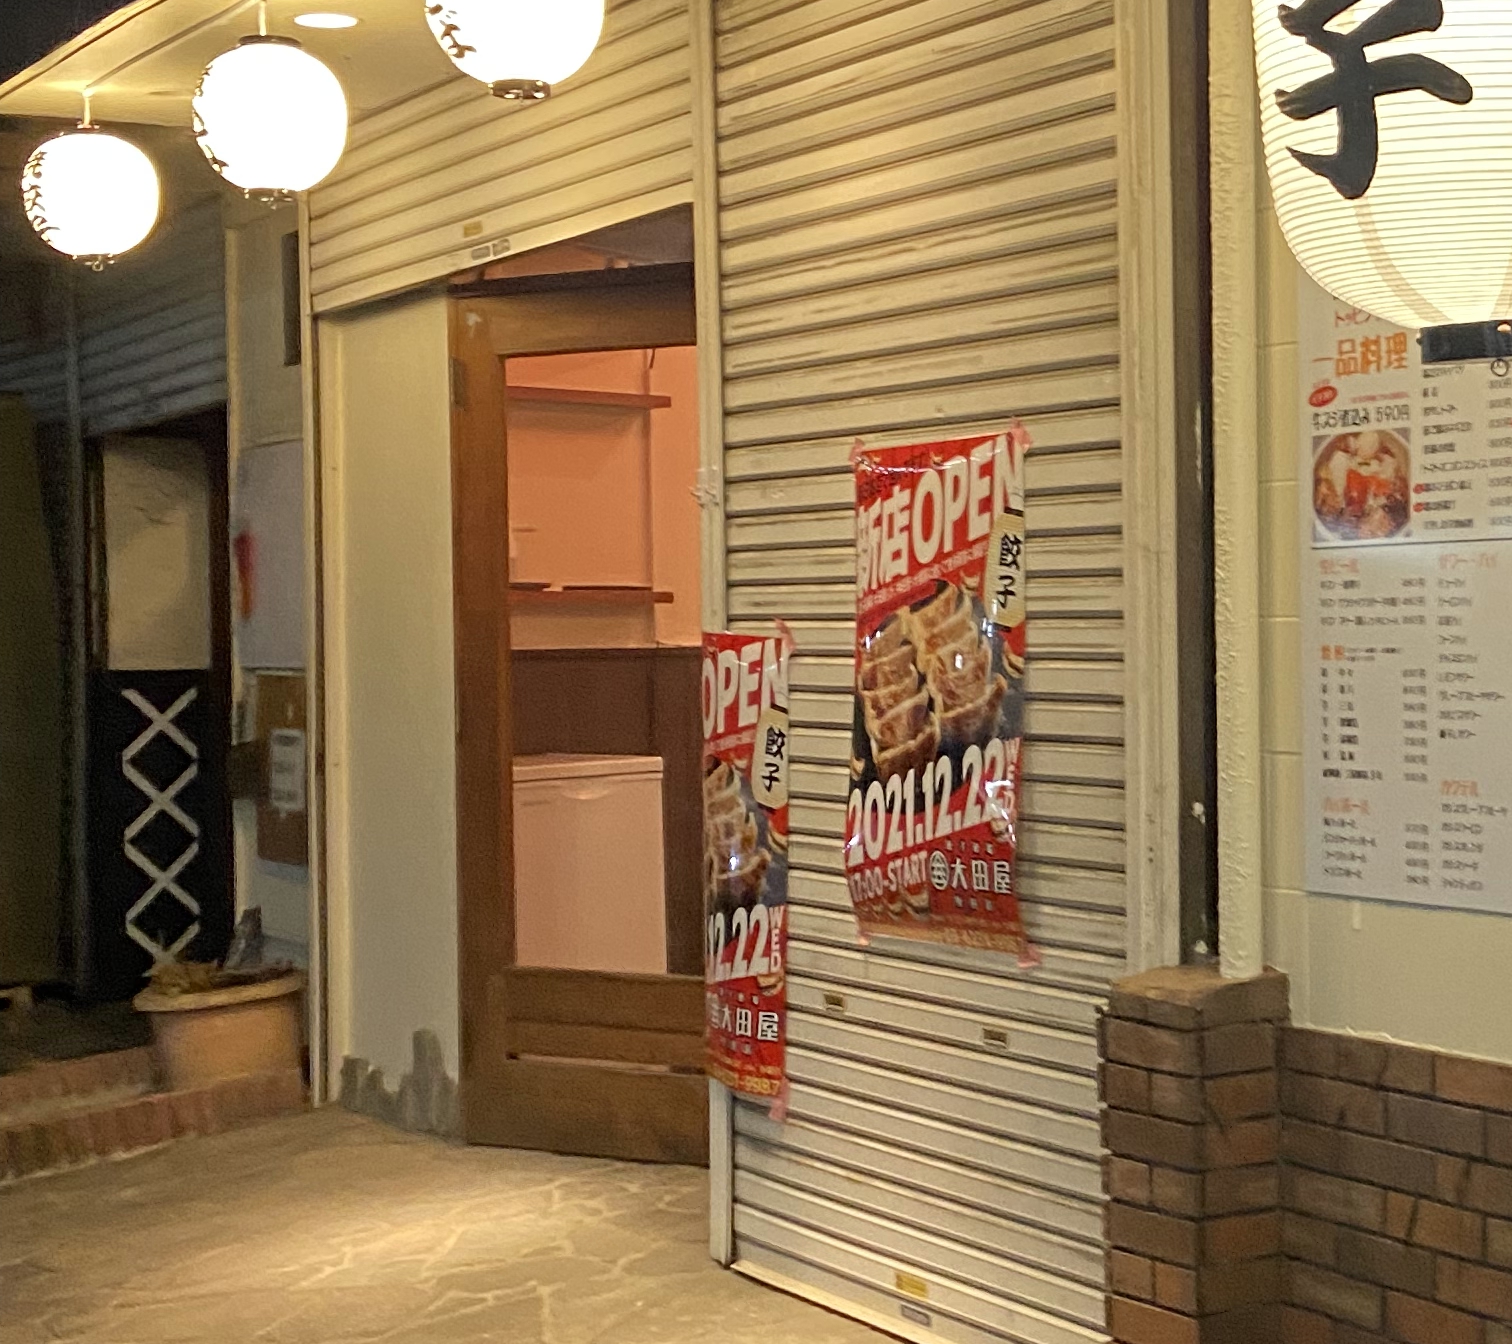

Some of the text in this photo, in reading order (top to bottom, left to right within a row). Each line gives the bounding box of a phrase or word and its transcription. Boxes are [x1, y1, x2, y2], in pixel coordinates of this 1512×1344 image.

[1312, 332, 1408, 377] 一品料理
[995, 532, 1023, 609] 餃子
[702, 637, 788, 740] OPEN
[761, 725, 786, 793] 餃子
[846, 737, 1006, 868] 2021.12.22
[950, 857, 1013, 895] 大田屋
[769, 906, 785, 975] WED
[721, 1004, 779, 1042] 大田屋
